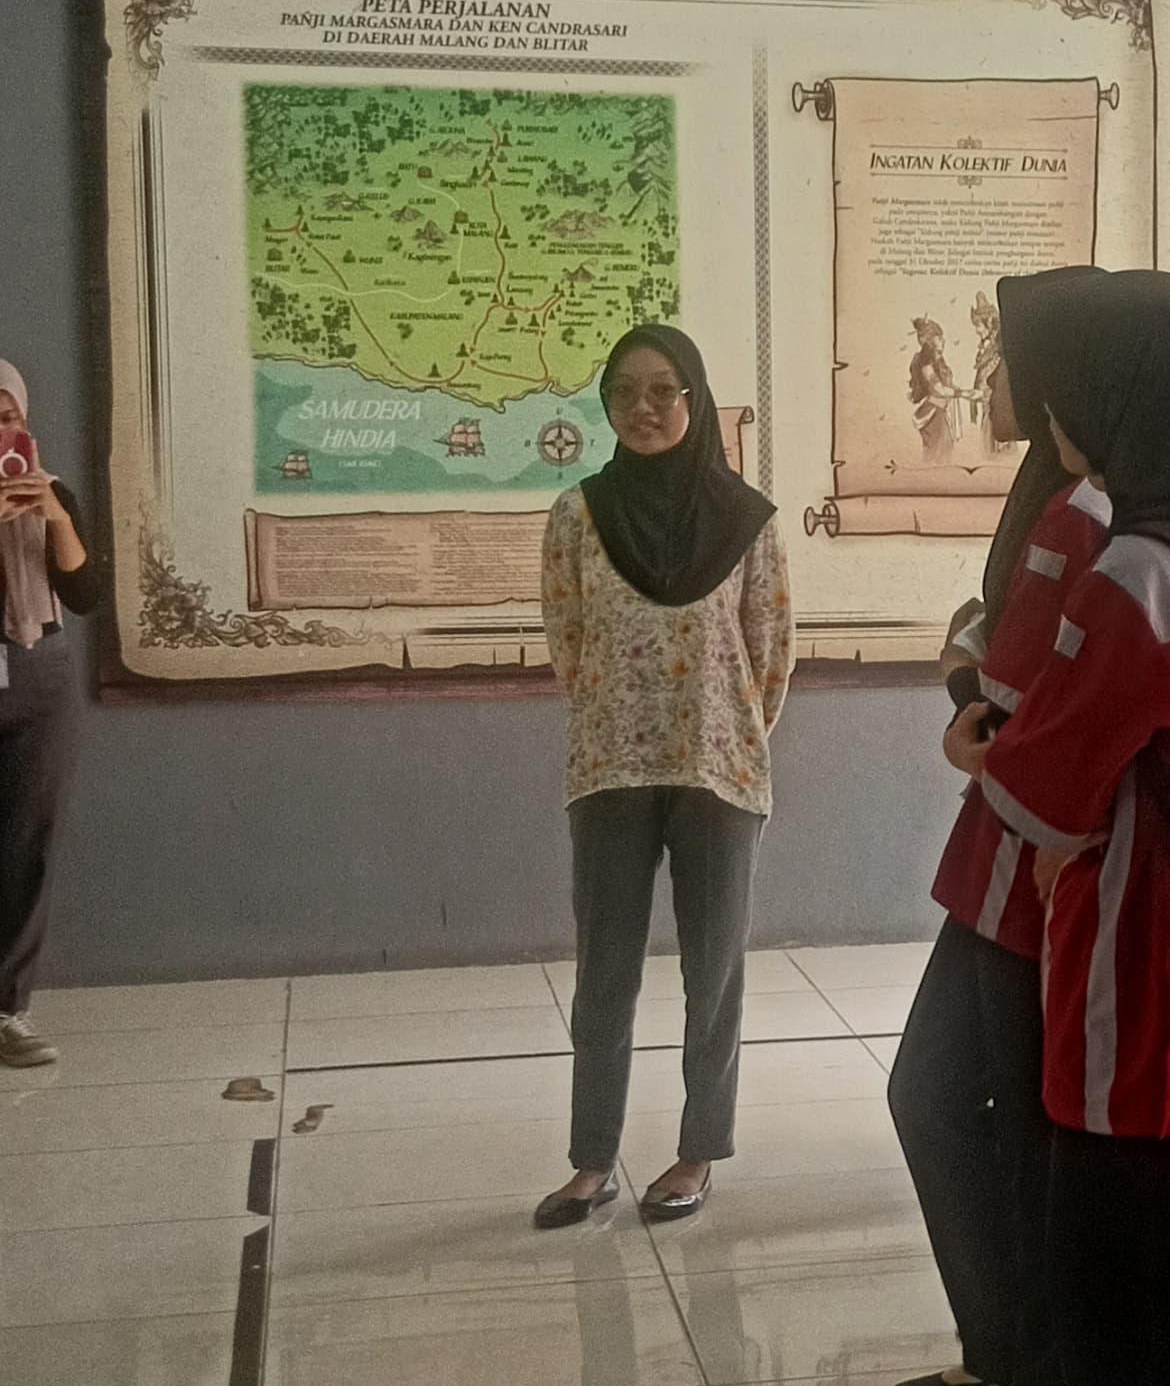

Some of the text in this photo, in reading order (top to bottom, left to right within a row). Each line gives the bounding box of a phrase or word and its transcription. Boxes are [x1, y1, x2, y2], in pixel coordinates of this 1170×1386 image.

[330, 14, 444, 31] MARGASMARA
[448, 18, 484, 32] DAN
[488, 20, 521, 33] KEN
[526, 21, 628, 37] CANDRASARI
[322, 30, 589, 52] DI DAERAH MALANG DAN BLITAR
[869, 152, 1067, 173] INGATAN KOLEKTIF DUNIA
[299, 399, 422, 421] SAMUDERA
[319, 428, 397, 449] HINDIA
